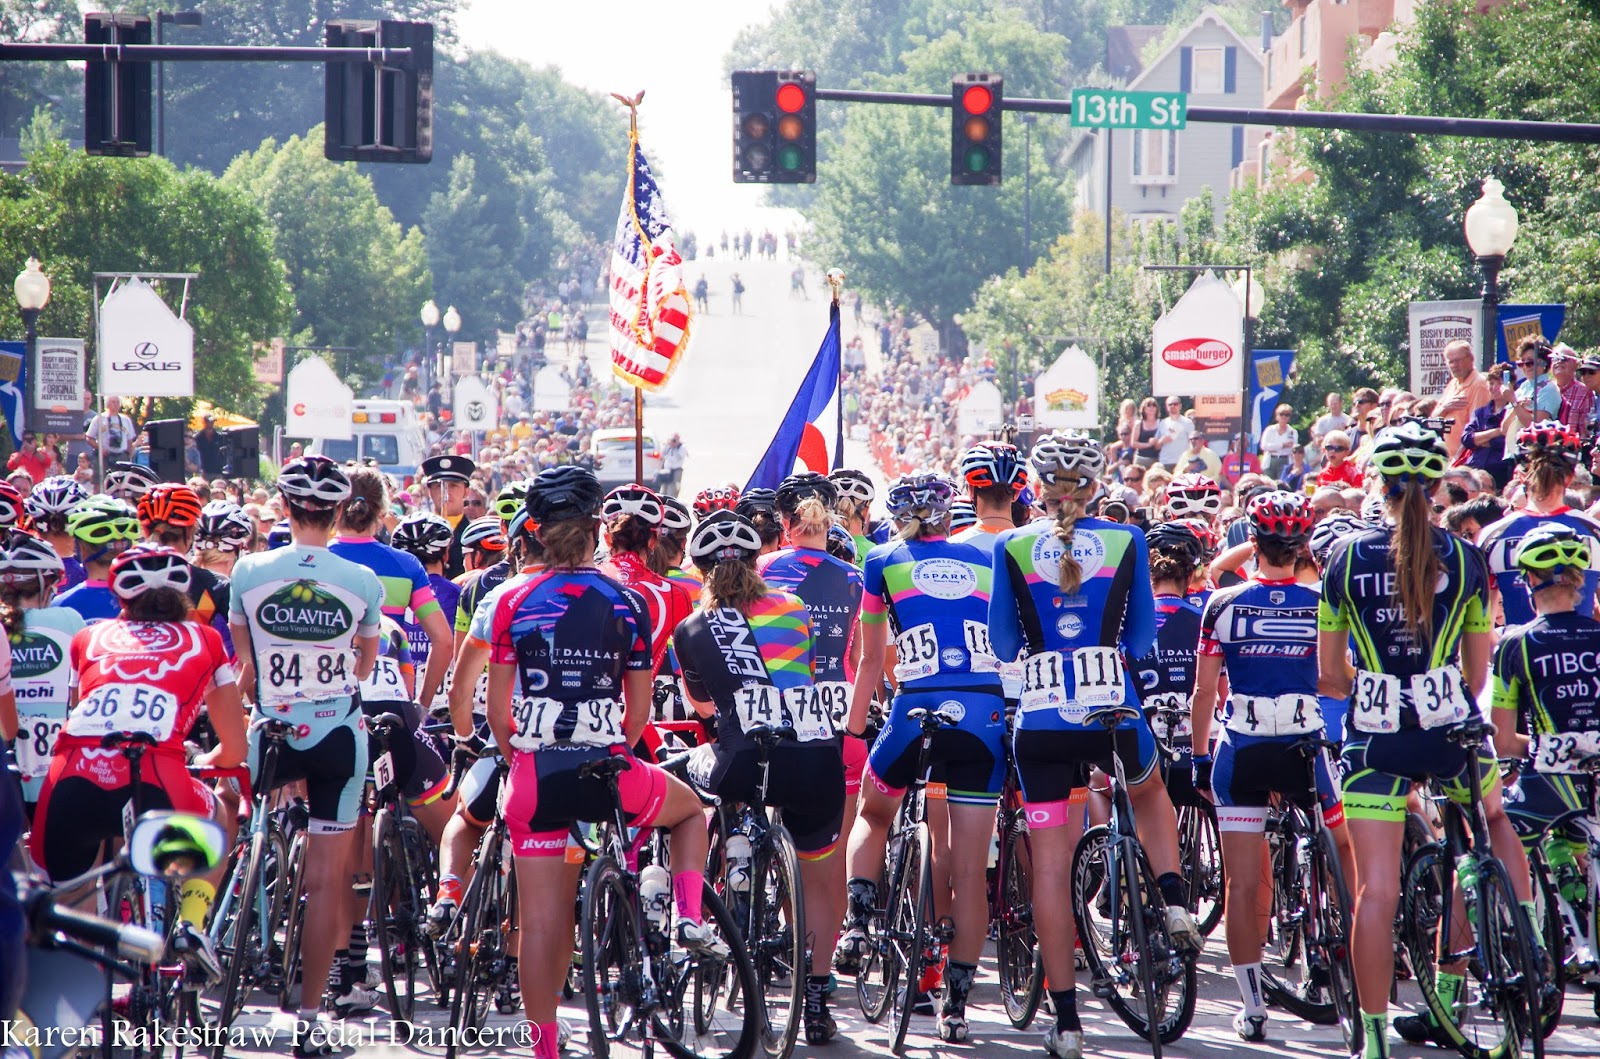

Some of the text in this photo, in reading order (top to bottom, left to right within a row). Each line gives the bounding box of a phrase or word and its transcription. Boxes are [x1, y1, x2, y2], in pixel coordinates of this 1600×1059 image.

[1077, 95, 1181, 126] 13th St
[1420, 328, 1443, 338] BUSHY
[1420, 339, 1446, 349] BANJOS
[1165, 348, 1229, 360] smashburger
[1421, 353, 1440, 367] GOLD
[112, 362, 181, 371] LEXUS
[1429, 371, 1449, 385] ORIG
[1421, 386, 1443, 395] HIPS
[1044, 548, 1092, 559] SPRK
[923, 573, 967, 581] SPARK
[1354, 572, 1399, 598] TIB
[260, 603, 349, 629] COLAVITA
[805, 604, 850, 613] DALLAS
[1236, 608, 1319, 617] TWENTY
[290, 625, 309, 634] Virgin
[310, 626, 327, 634] Olive
[327, 627, 337, 635] Oil
[717, 607, 769, 680] DNA
[967, 626, 994, 656] 11
[1239, 644, 1309, 656] SHO-AIR
[10, 644, 59, 663] AVITA
[1135, 649, 1198, 662] VISITDALL
[23, 662, 39, 670] Olive
[269, 653, 347, 687] 84 84
[1024, 652, 1122, 693] 111 111
[15, 687, 54, 698] nchi
[1360, 671, 1453, 716] 34 34
[1556, 679, 1589, 699] svb
[82, 688, 121, 718] 56
[130, 688, 167, 722] 56
[742, 688, 823, 723] 74 74
[821, 685, 848, 717] 93
[518, 701, 616, 738] 91 91
[1246, 699, 1306, 731] 4 4
[413, 730, 445, 763] CYCLI
[1545, 737, 1577, 767] 33
[89, 764, 112, 778] happy
[97, 759, 108, 768] the
[98, 773, 117, 784] tooth
[378, 762, 390, 787] 75
[1076, 836, 1108, 916] EYNOLDS
[807, 983, 822, 1013] DNA
